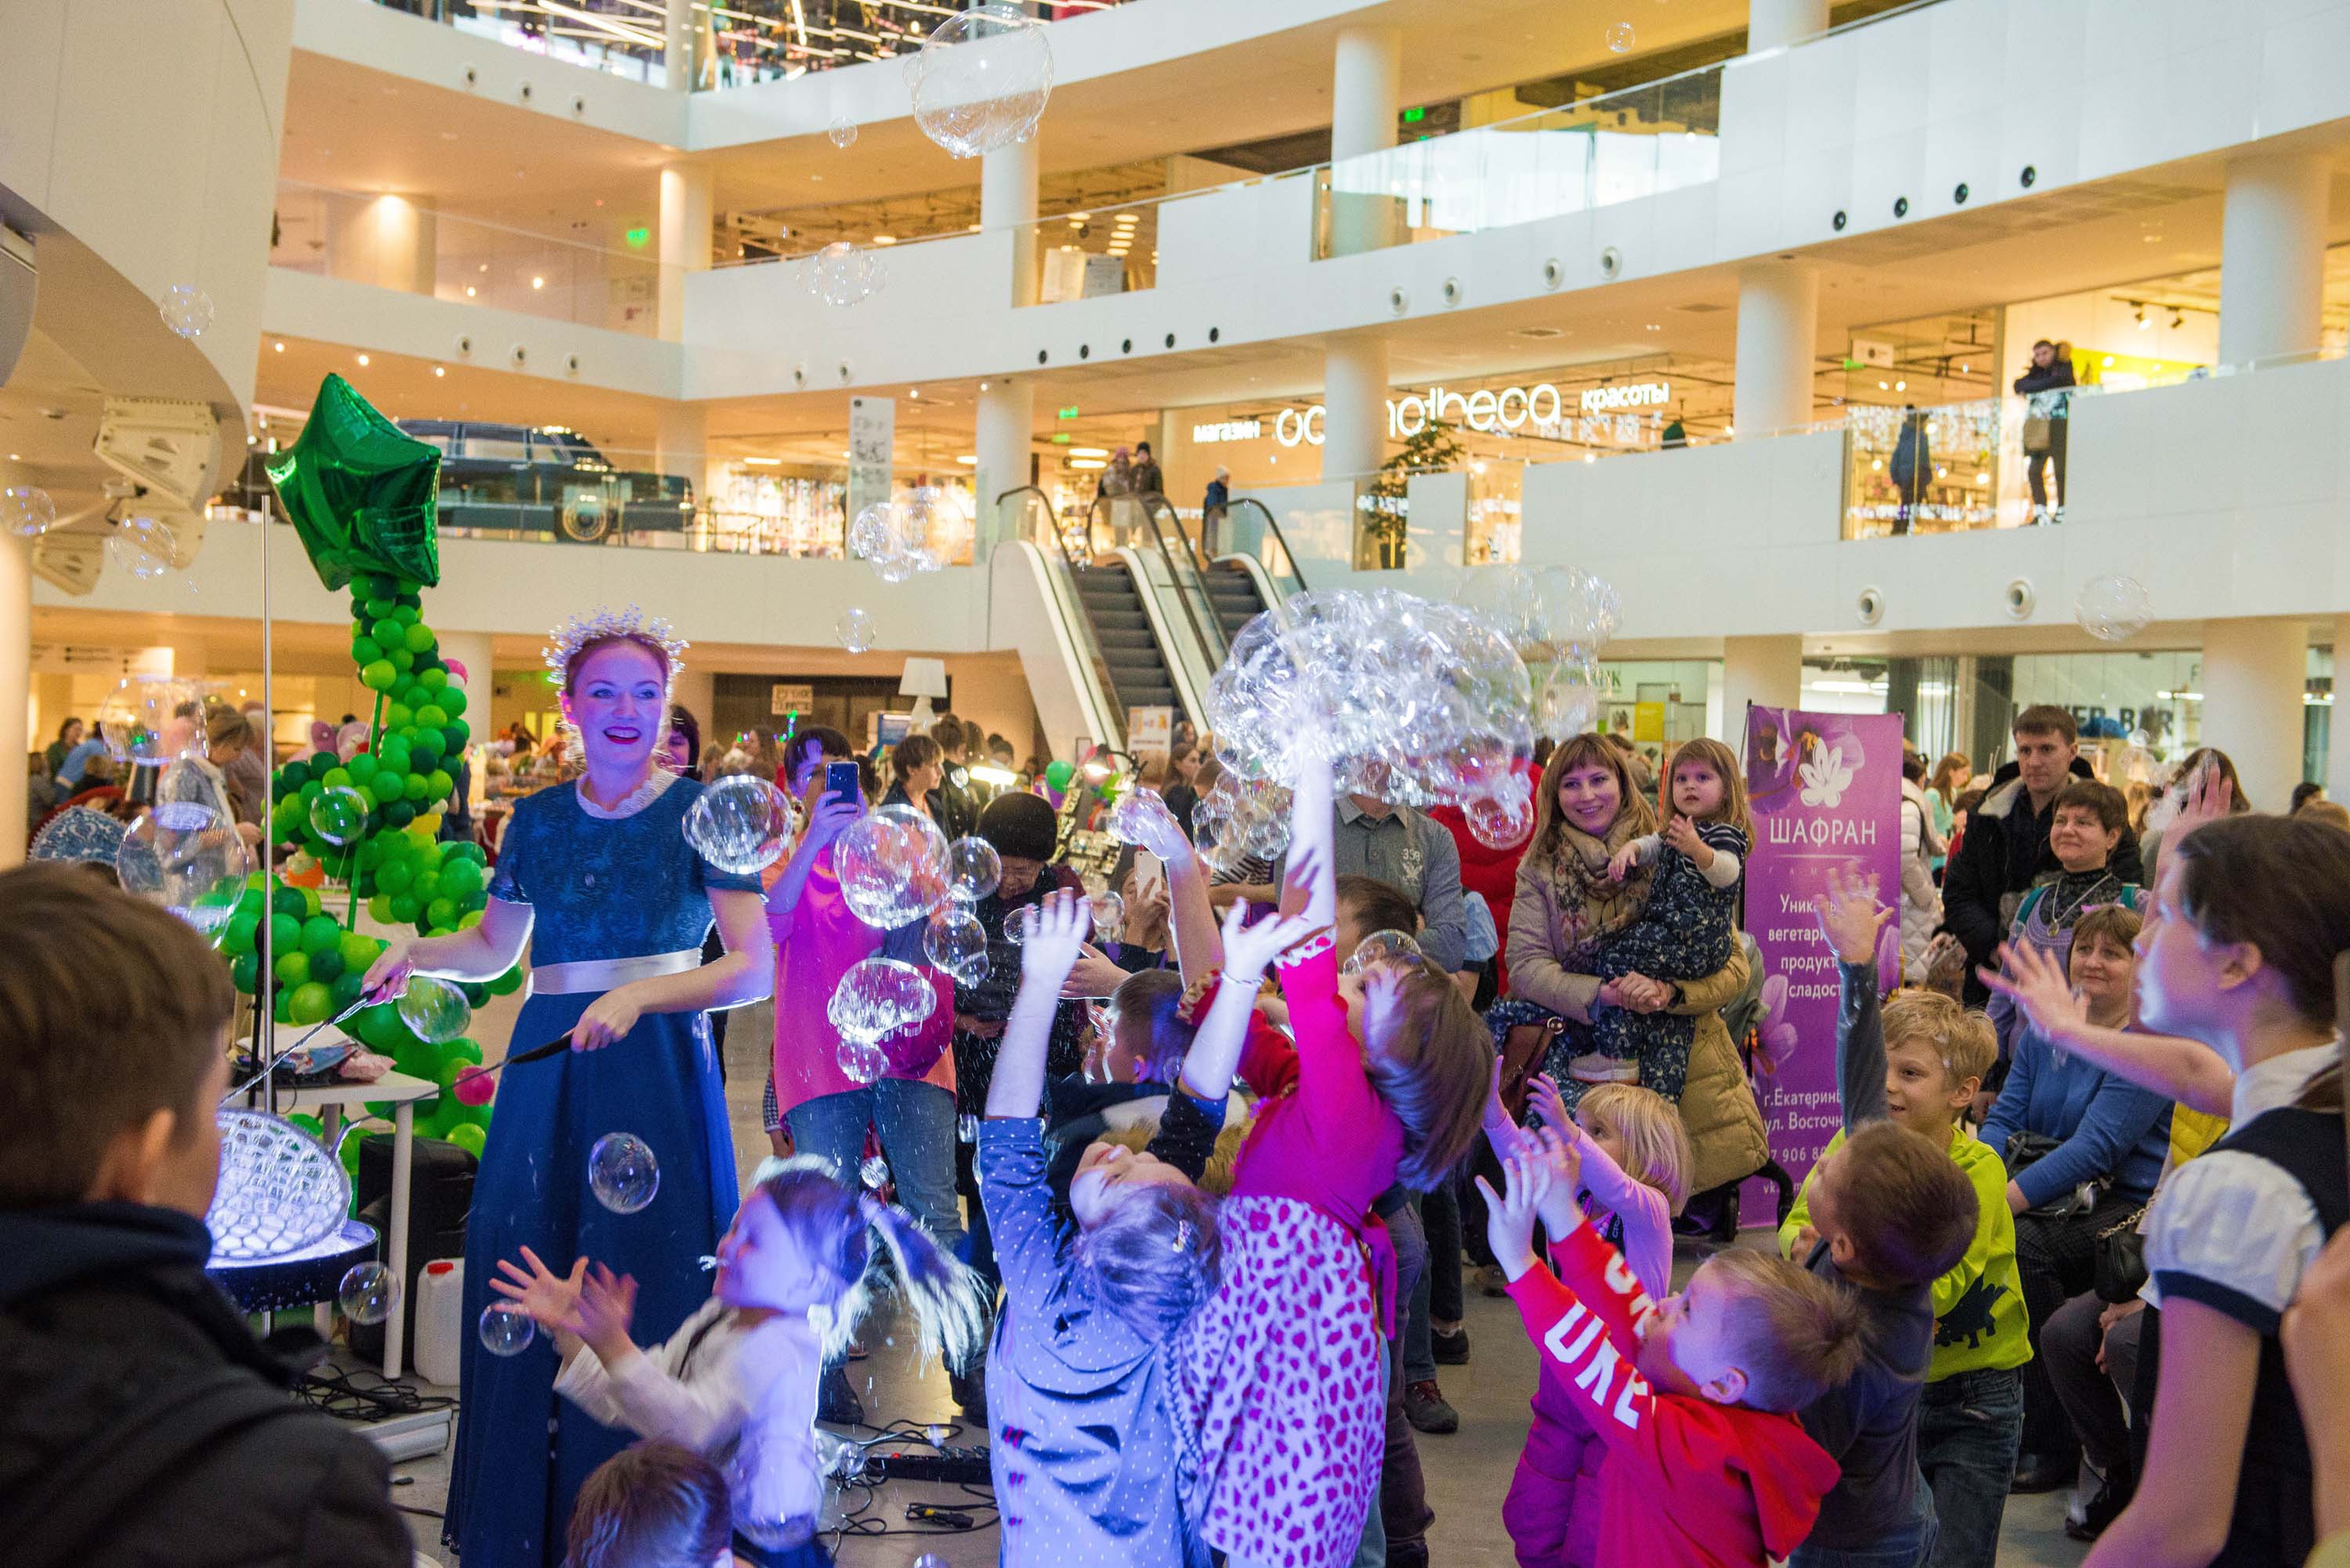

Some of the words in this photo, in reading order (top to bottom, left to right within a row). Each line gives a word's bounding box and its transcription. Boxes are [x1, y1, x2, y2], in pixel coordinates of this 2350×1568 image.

[1581, 382, 1669, 415] красоты
[1770, 817, 1875, 847] ШАФРАН
[1781, 956, 1838, 975] продукт
[1789, 984, 1841, 1000] сладост
[1788, 1112, 1843, 1130] Восточн
[1783, 1147, 1806, 1162] 906
